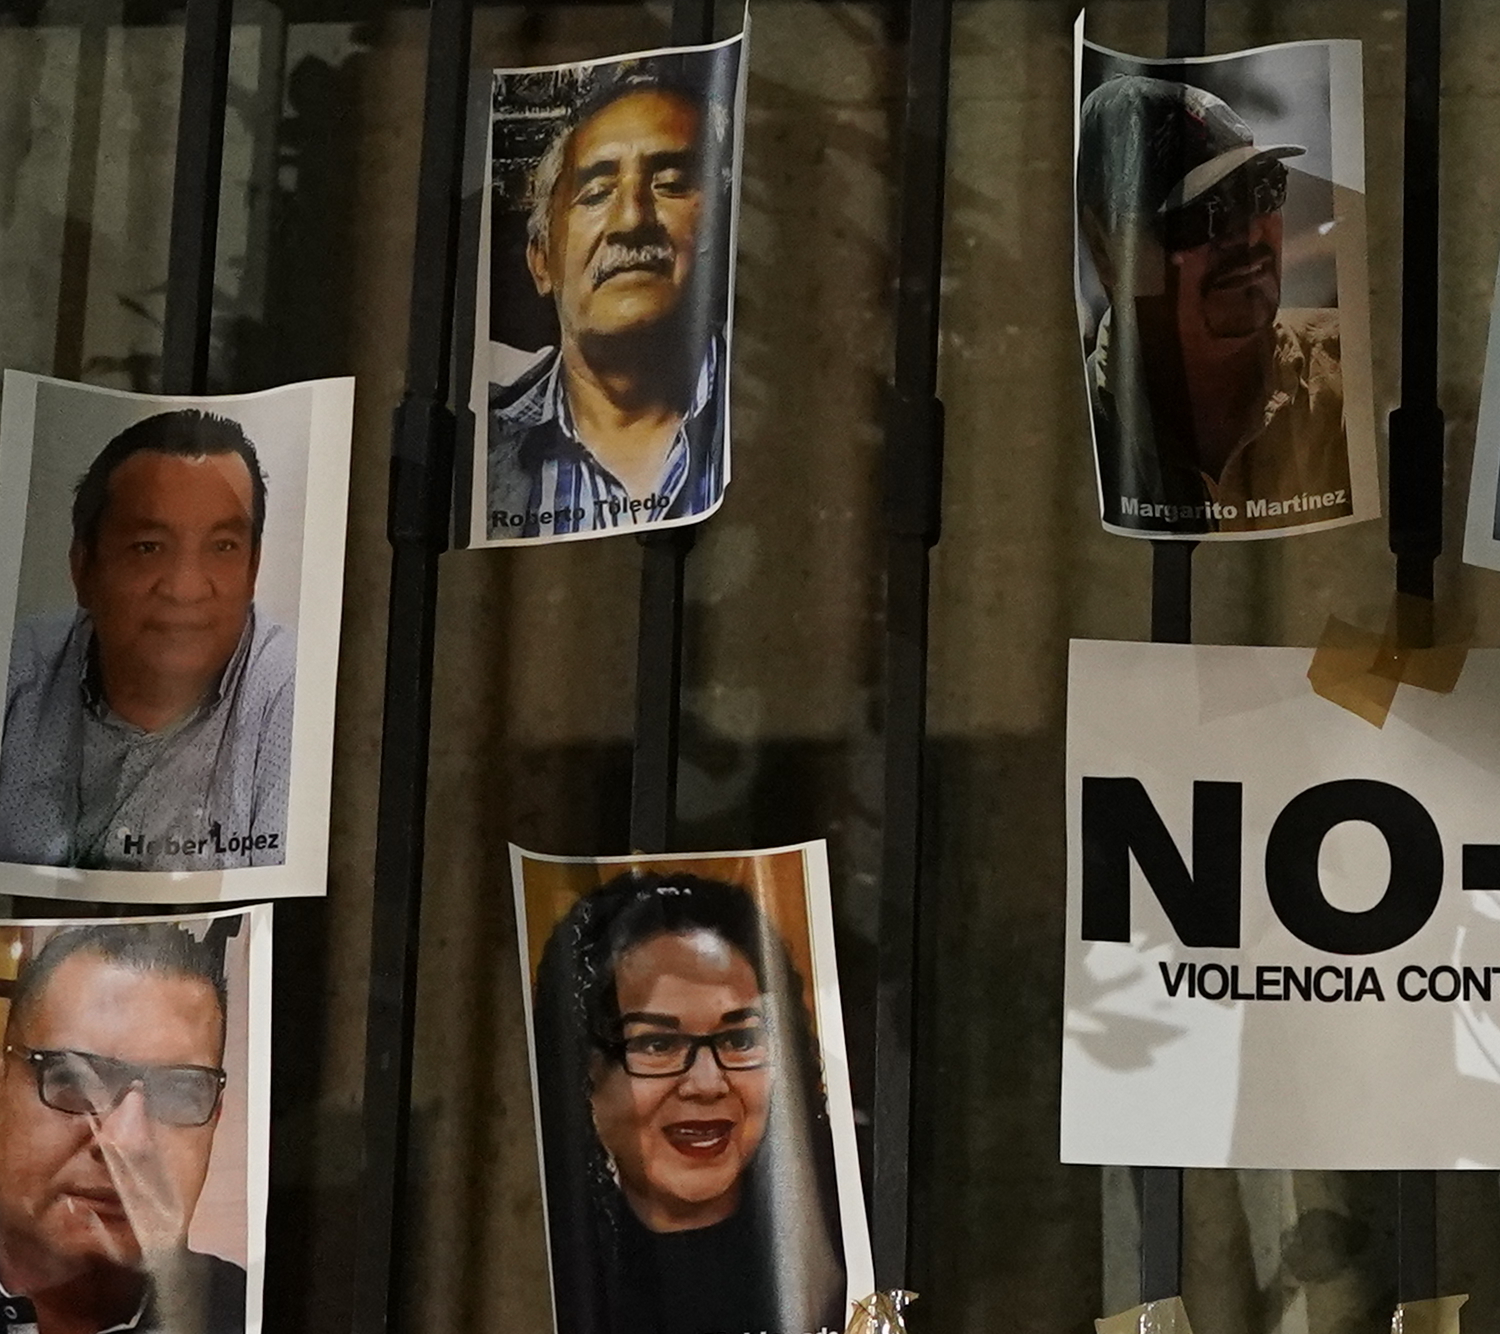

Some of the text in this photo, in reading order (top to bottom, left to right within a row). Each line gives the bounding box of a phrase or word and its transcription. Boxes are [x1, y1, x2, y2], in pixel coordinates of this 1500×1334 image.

[492, 492, 671, 528] Roberto Toledo
[1120, 489, 1346, 523] Margarito Martínez
[214, 832, 280, 857] López
[1158, 961, 1385, 1003] VIOLENCIA
